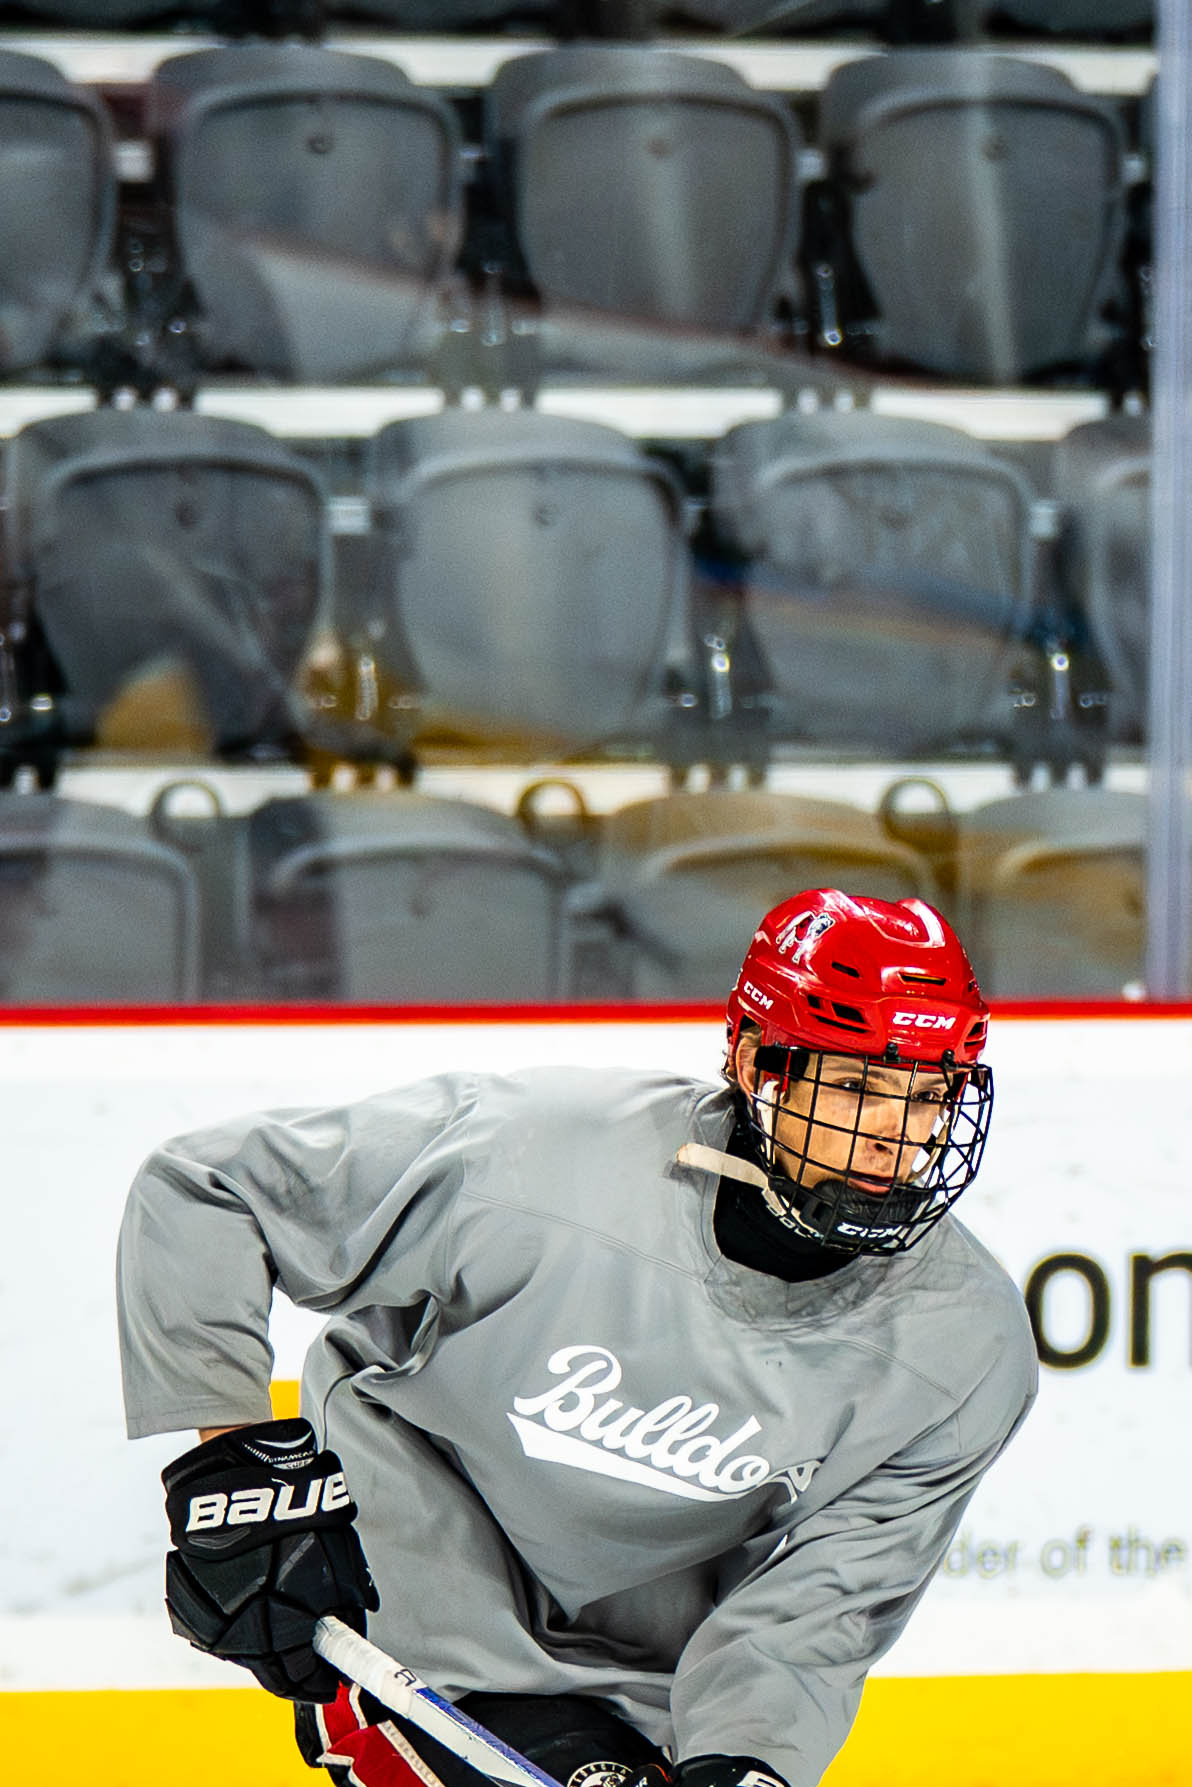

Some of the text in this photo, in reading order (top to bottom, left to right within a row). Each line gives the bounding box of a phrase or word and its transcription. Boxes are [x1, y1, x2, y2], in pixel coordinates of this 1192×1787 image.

[743, 981, 774, 1011] CCM
[892, 1011, 956, 1031] CCM
[1041, 1525, 1092, 1578] of
[1108, 1525, 1188, 1576] the
